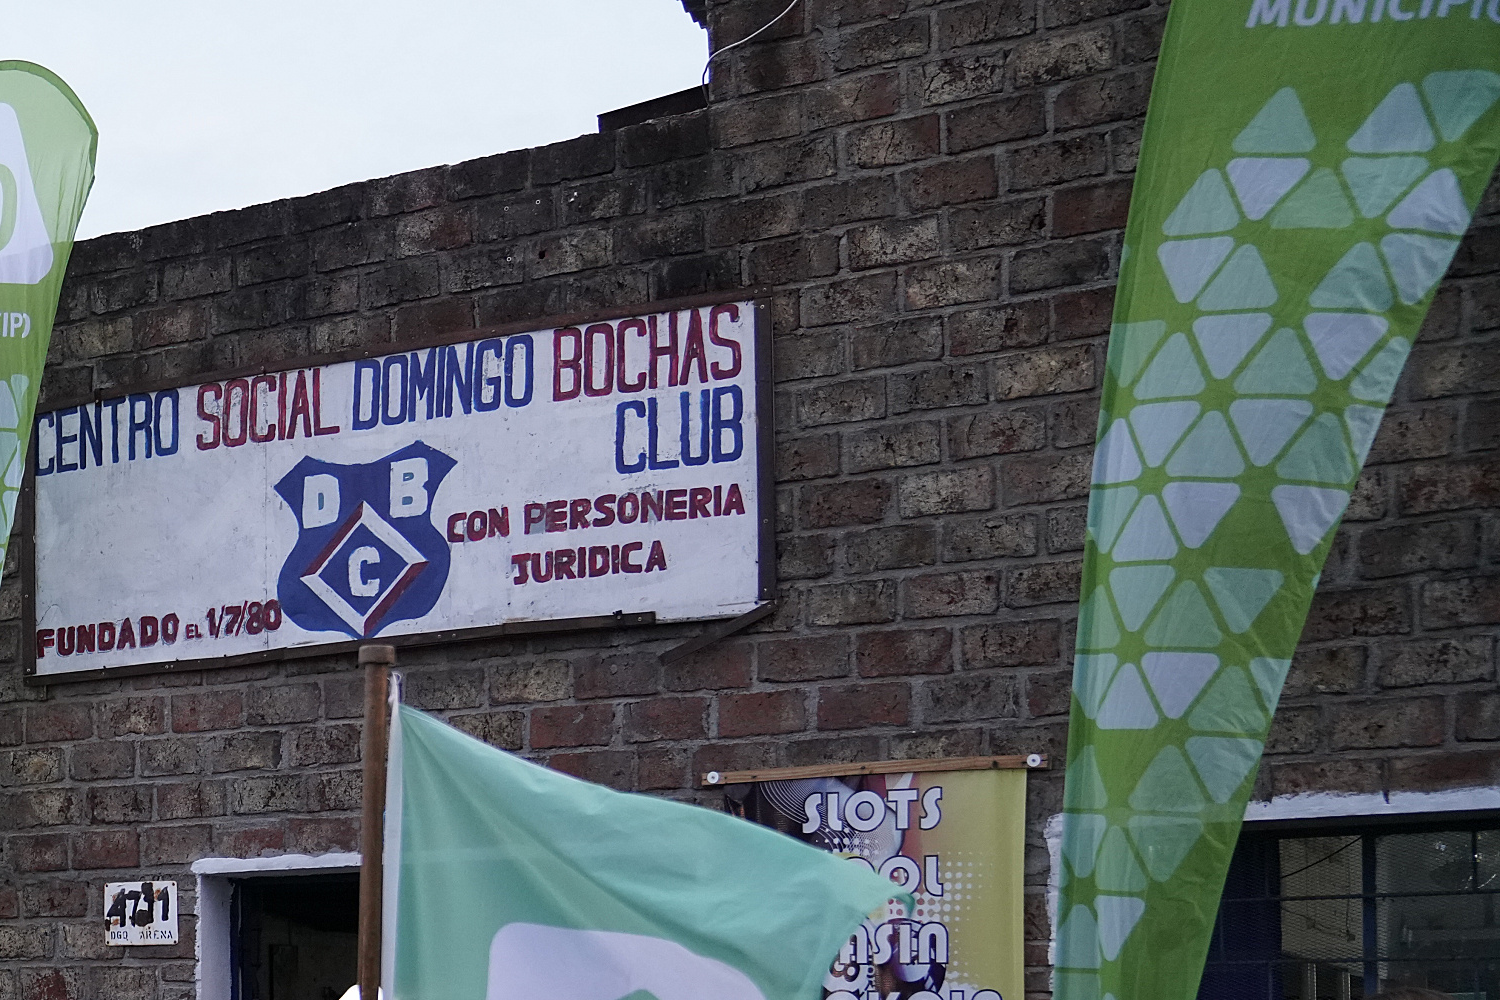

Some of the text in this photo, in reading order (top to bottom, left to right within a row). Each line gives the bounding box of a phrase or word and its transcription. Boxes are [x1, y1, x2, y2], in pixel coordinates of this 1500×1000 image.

[36, 303, 743, 477] CENTRO SOCIAL DOMINGO BOCHAS
[615, 384, 744, 474] CLUB
[302, 456, 431, 530] D B
[447, 484, 746, 544] CON PERSONERIA
[349, 546, 381, 598] C
[511, 540, 667, 585] JURIDICA
[36, 598, 283, 659] FUNDADO EL 1/7/80
[802, 786, 943, 834] SLOTS
[845, 854, 944, 897] OL
